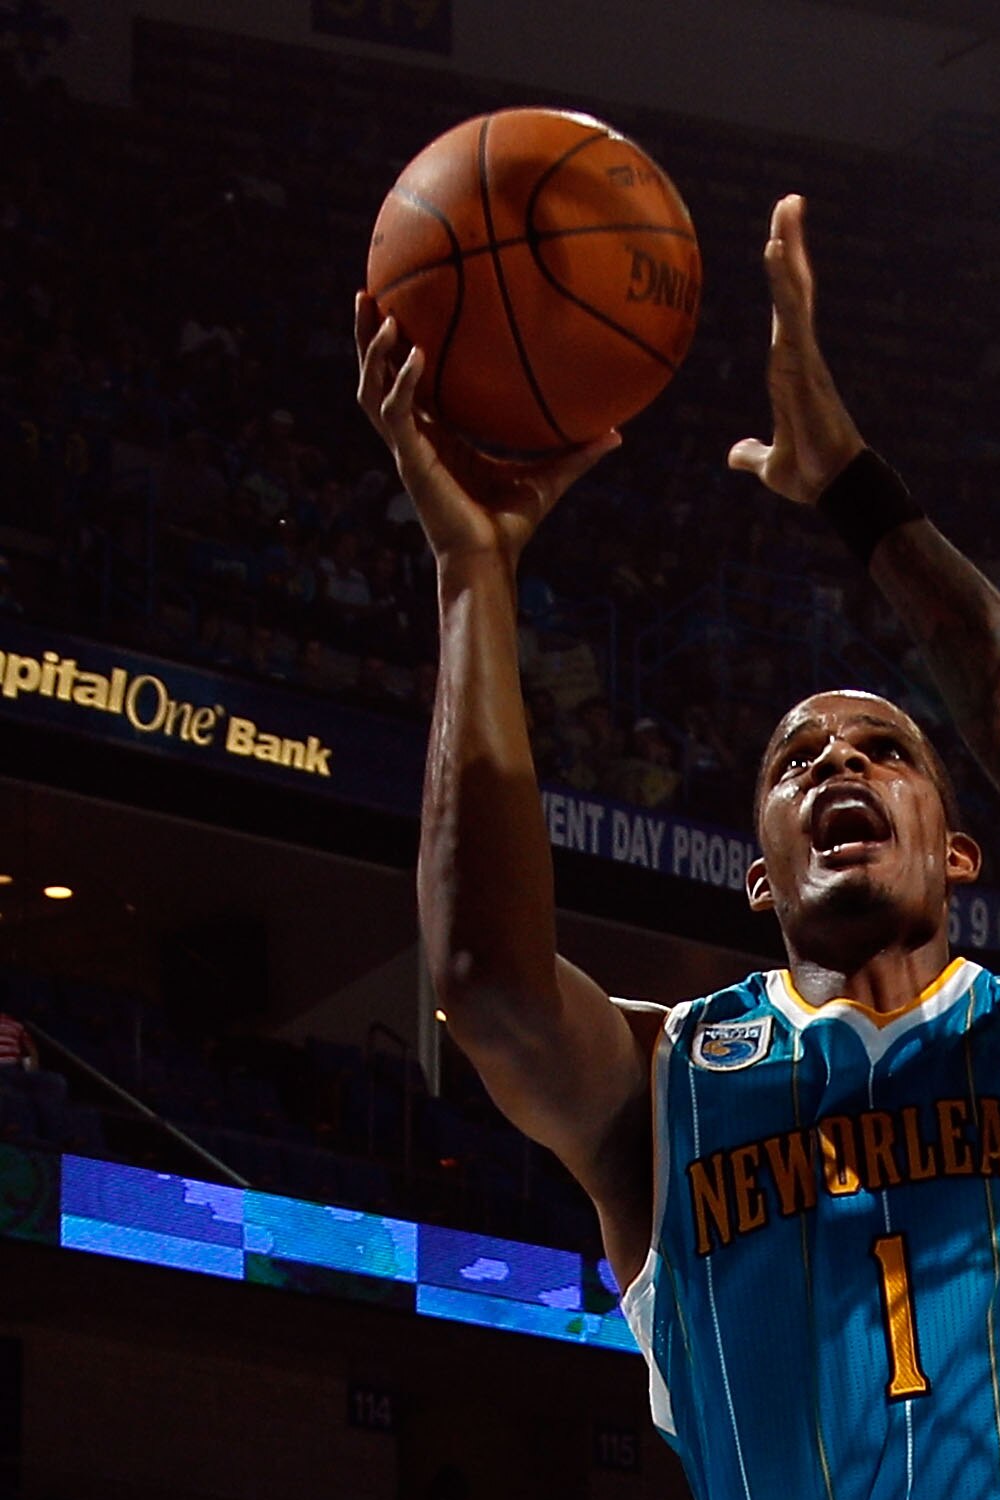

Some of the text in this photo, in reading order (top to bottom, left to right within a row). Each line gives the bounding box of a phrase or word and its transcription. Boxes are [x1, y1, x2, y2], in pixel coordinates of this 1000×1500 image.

[225, 714, 333, 778] Bank
[612, 808, 666, 870] DAY
[871, 1233, 930, 1402] 1
[354, 1391, 391, 1425] 114
[601, 1433, 635, 1465] 115
